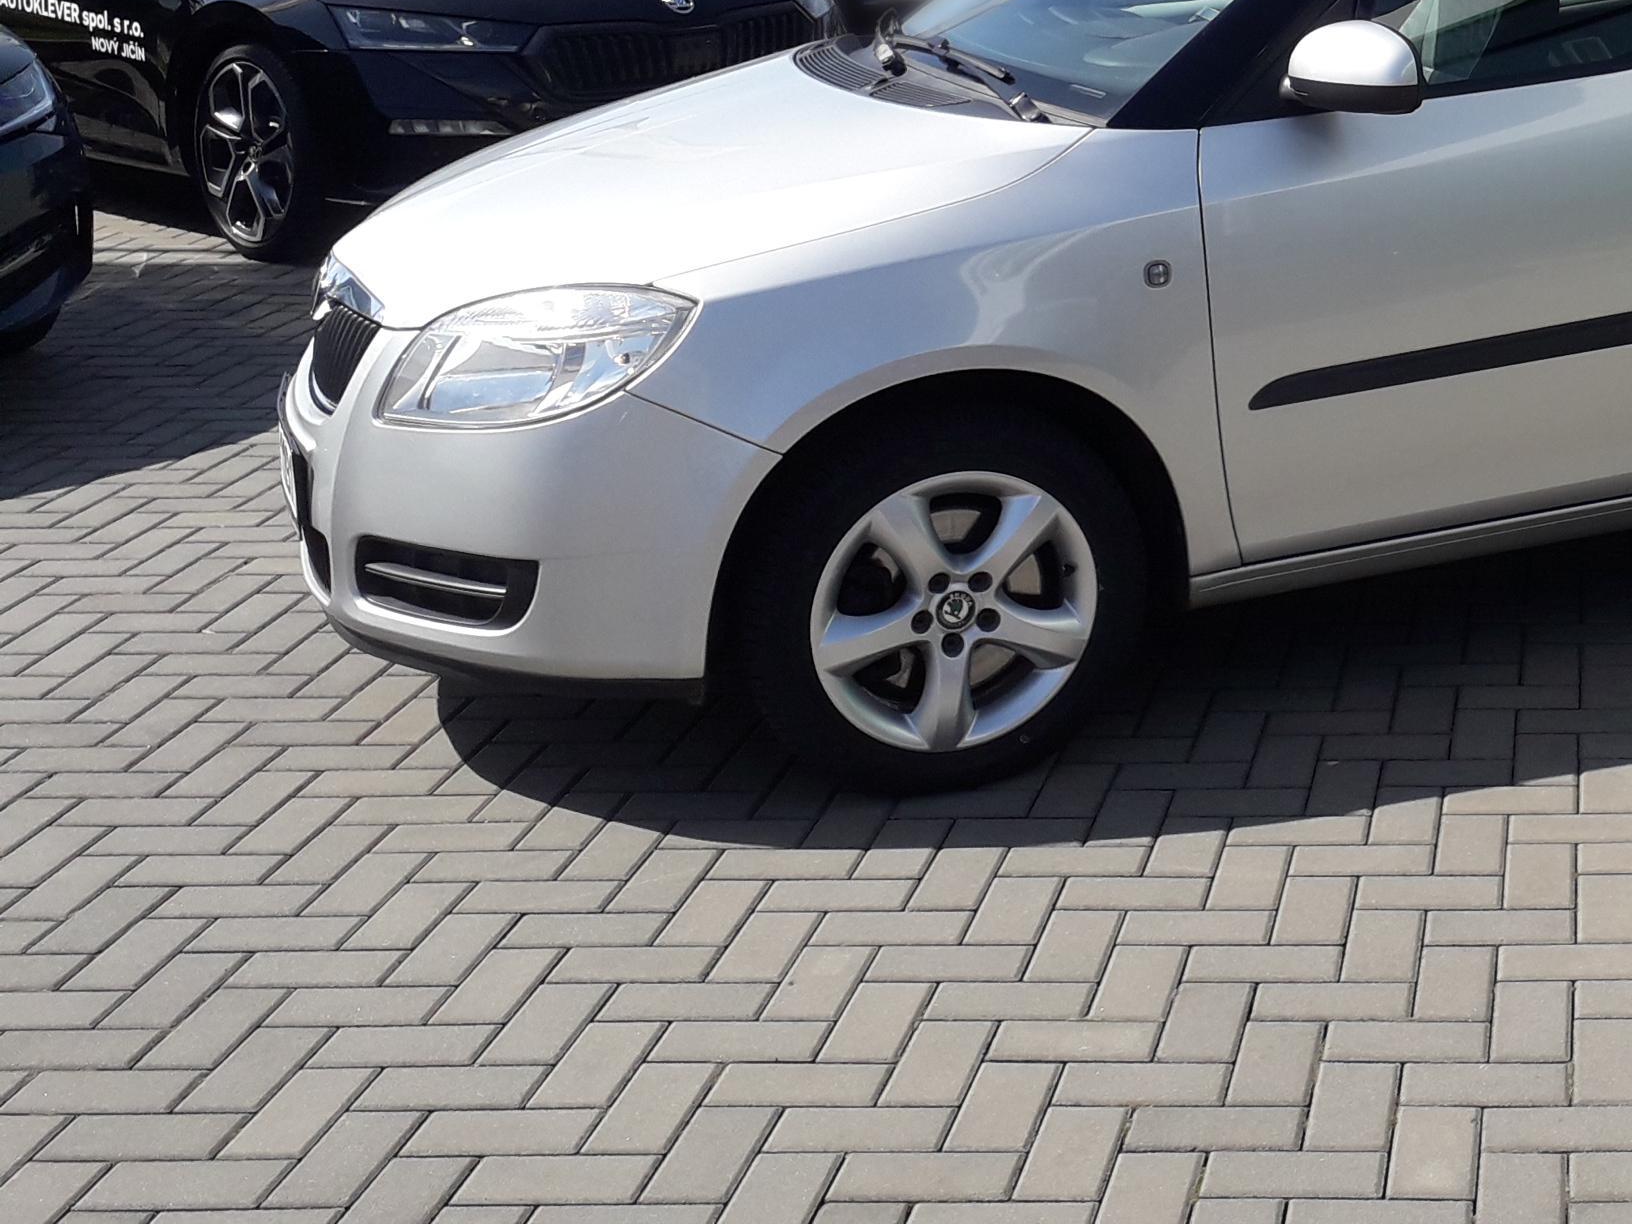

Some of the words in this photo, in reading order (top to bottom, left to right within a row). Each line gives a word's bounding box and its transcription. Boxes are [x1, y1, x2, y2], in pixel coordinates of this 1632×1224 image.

[81, 9, 112, 32] spol.
[113, 17, 122, 33] s
[124, 19, 145, 38] r.o.
[91, 36, 119, 55] NOVÝ
[121, 40, 146, 62] JIČÍN
